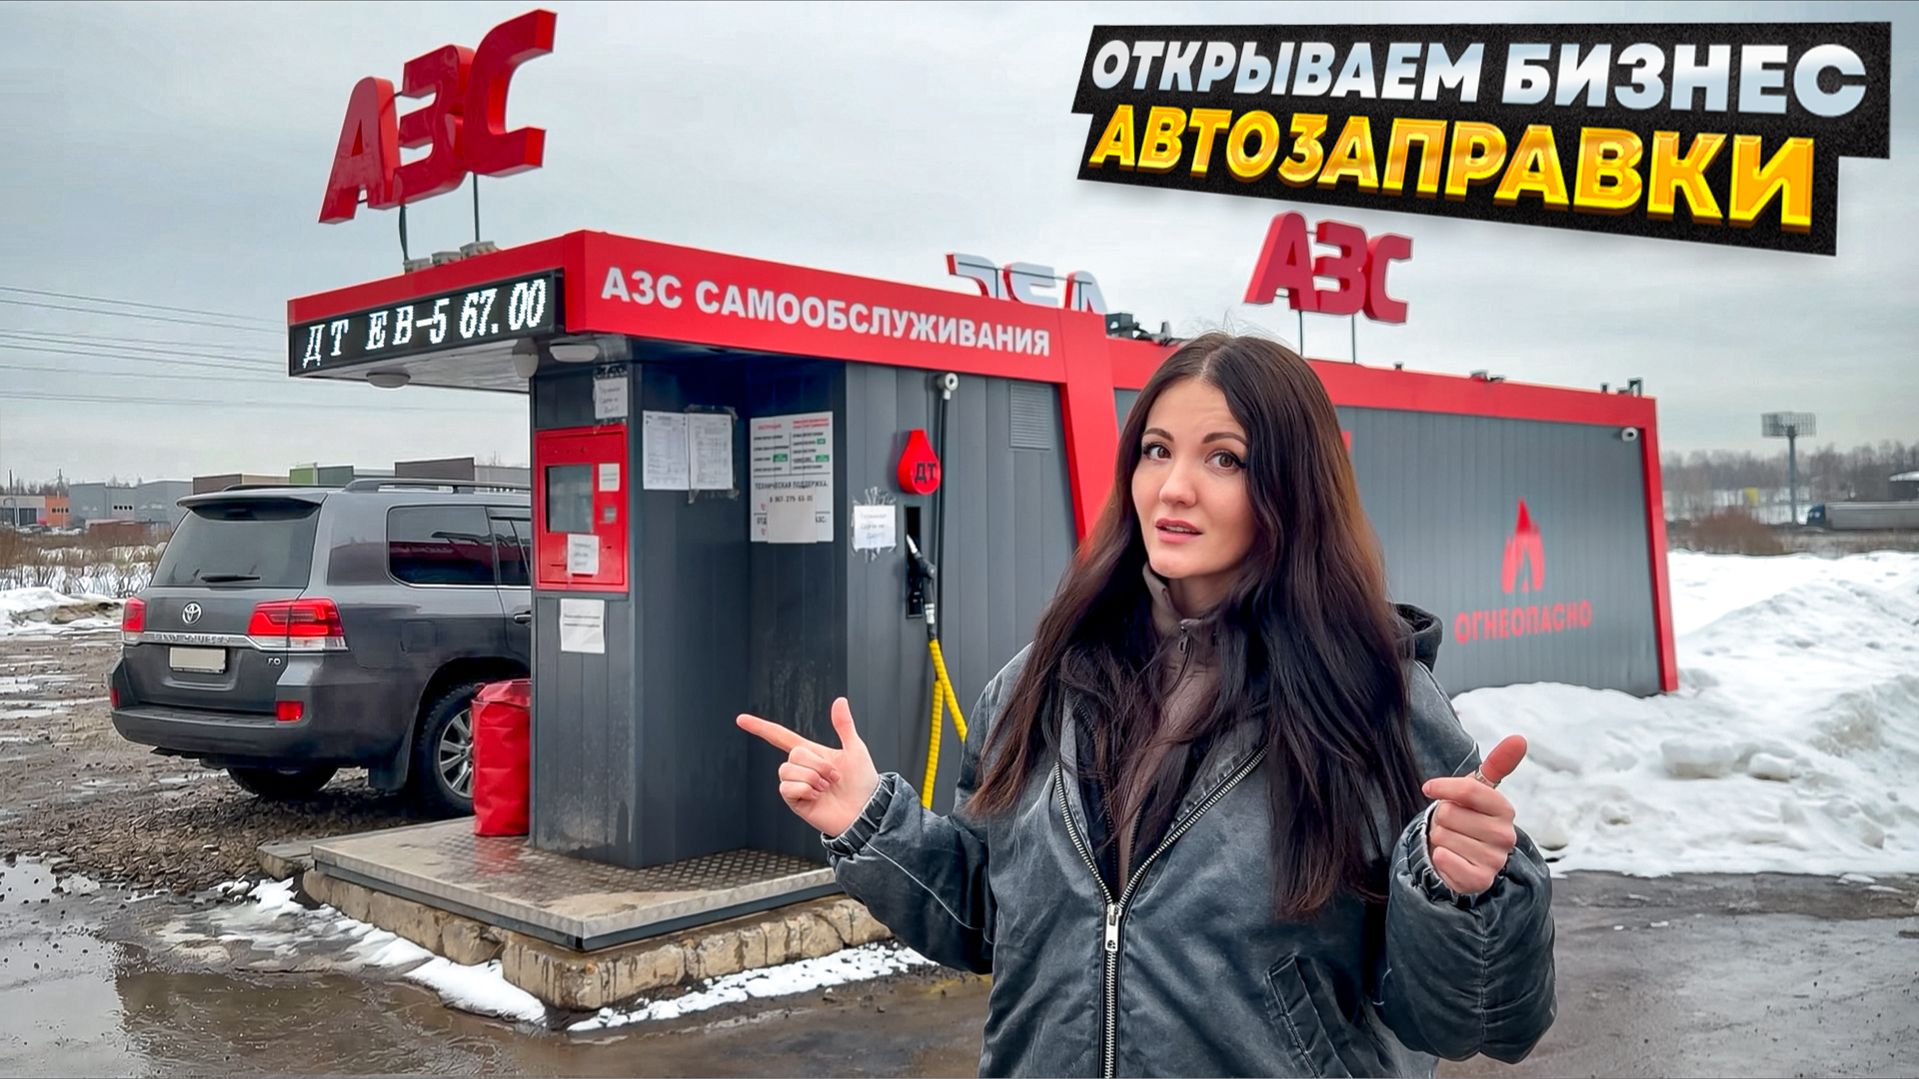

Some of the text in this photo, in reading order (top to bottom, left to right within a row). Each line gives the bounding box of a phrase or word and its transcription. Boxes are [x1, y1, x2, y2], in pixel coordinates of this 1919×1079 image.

[318, 8, 557, 224] АЗС
[601, 266, 1050, 357] АЗС САМООБСЛУЖИВАНИЯ
[1244, 211, 1413, 324] АЗС
[303, 318, 349, 369] ДТ
[460, 278, 547, 339] 67.00
[915, 462, 936, 483] ДТ
[1454, 599, 1594, 645] ОГНЕОПАСНО
